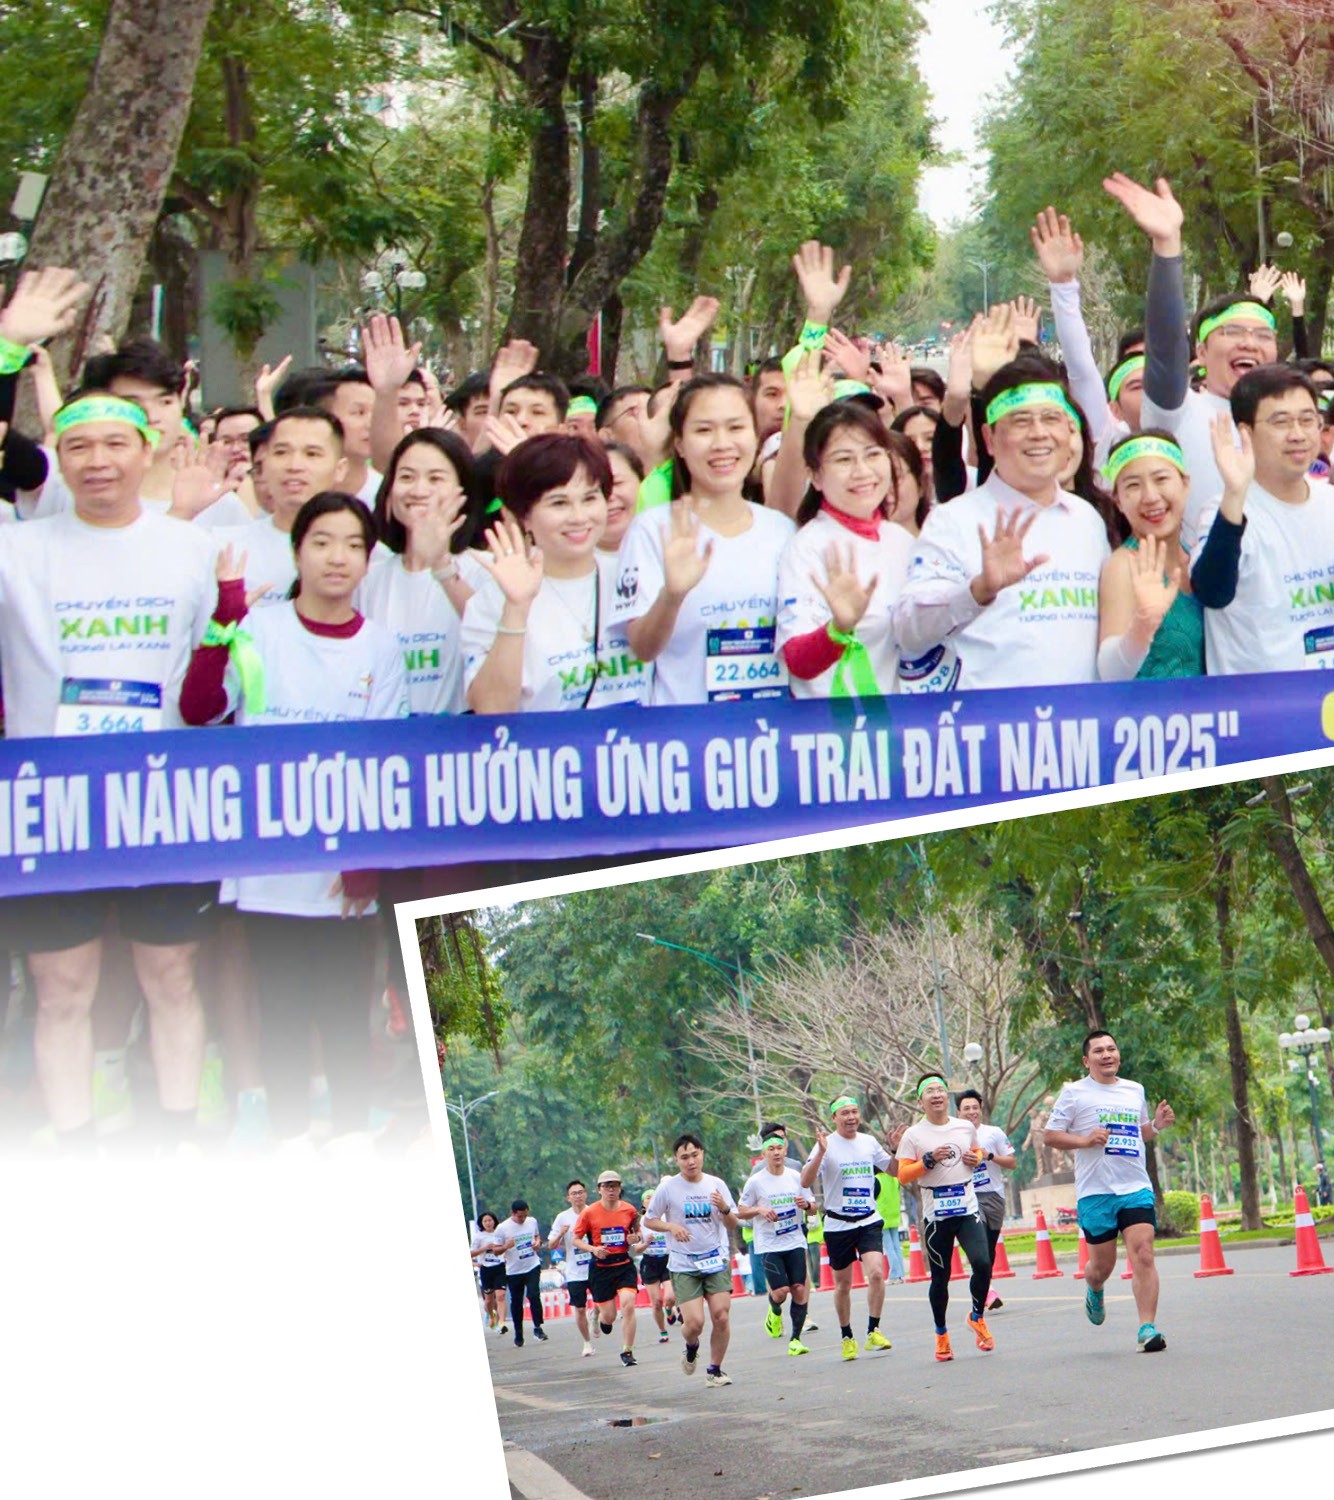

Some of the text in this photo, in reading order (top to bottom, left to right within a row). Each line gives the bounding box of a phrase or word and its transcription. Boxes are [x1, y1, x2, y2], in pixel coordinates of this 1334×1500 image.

[1019, 587, 1098, 611] XANH
[59, 615, 169, 640] XANH
[403, 648, 440, 671] NH
[558, 653, 644, 691] XANH
[715, 661, 781, 682] 22.664
[77, 713, 144, 732] 3.664
[106, 753, 242, 849] NĂNG
[256, 750, 411, 852] LƯỢNG
[426, 726, 584, 827] HƯỞNG
[595, 727, 691, 818] ỨNG
[705, 719, 779, 811] GIỜ
[791, 716, 889, 805] TRÁI
[903, 701, 986, 799] ĐẤT
[1000, 706, 1100, 794] NĂM
[1113, 709, 1240, 788] 2025"
[1099, 1113, 1138, 1123] XANH
[841, 1166, 871, 1176] XANH
